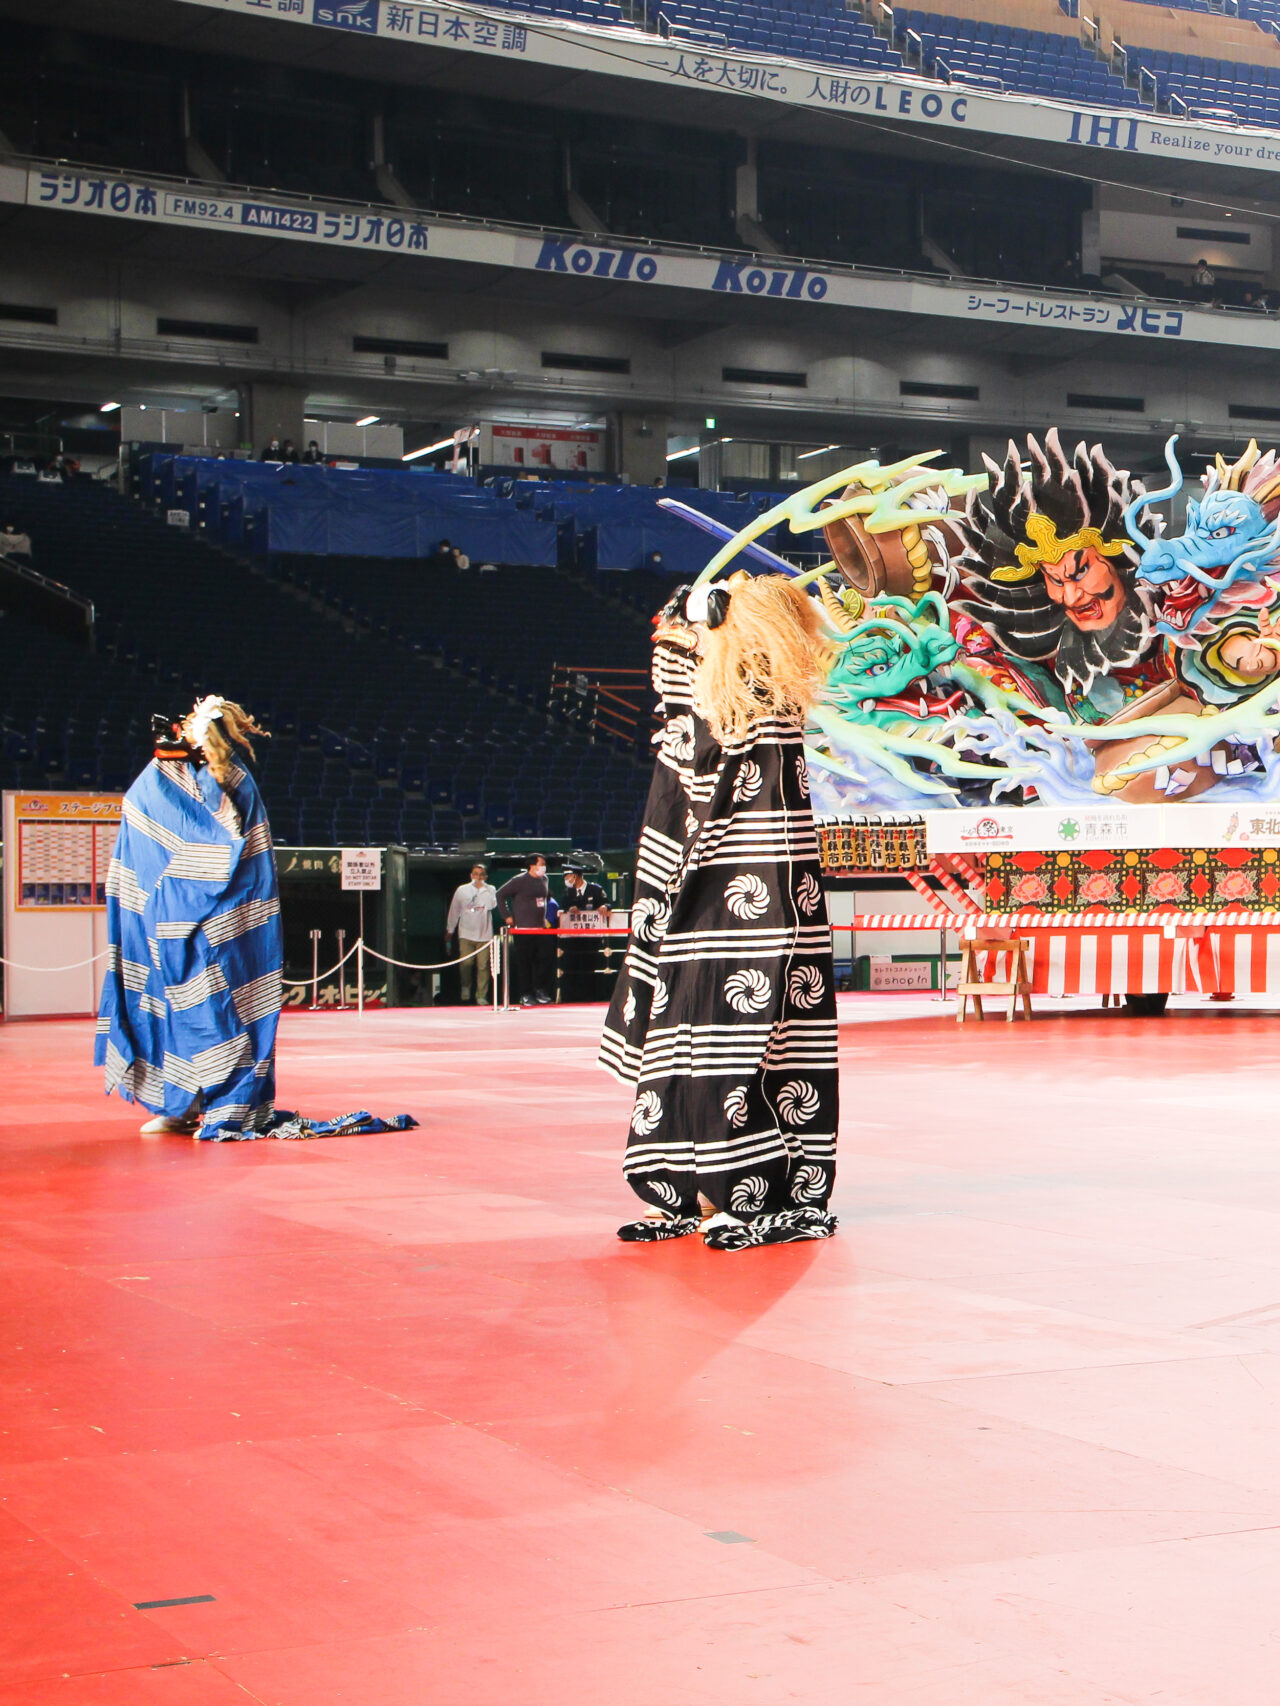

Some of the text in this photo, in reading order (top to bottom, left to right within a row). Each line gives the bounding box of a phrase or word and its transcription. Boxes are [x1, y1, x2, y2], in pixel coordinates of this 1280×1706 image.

[386, 6, 528, 52] 新日本空調
[1066, 112, 1139, 151] IHI
[1150, 130, 1211, 151] Realize
[1214, 143, 1253, 157] your
[39, 173, 430, 251] ラジオ日本 FM92.4 AM1422 ラジオ日本
[967, 294, 1184, 336] シーフードレストラン メヒコ
